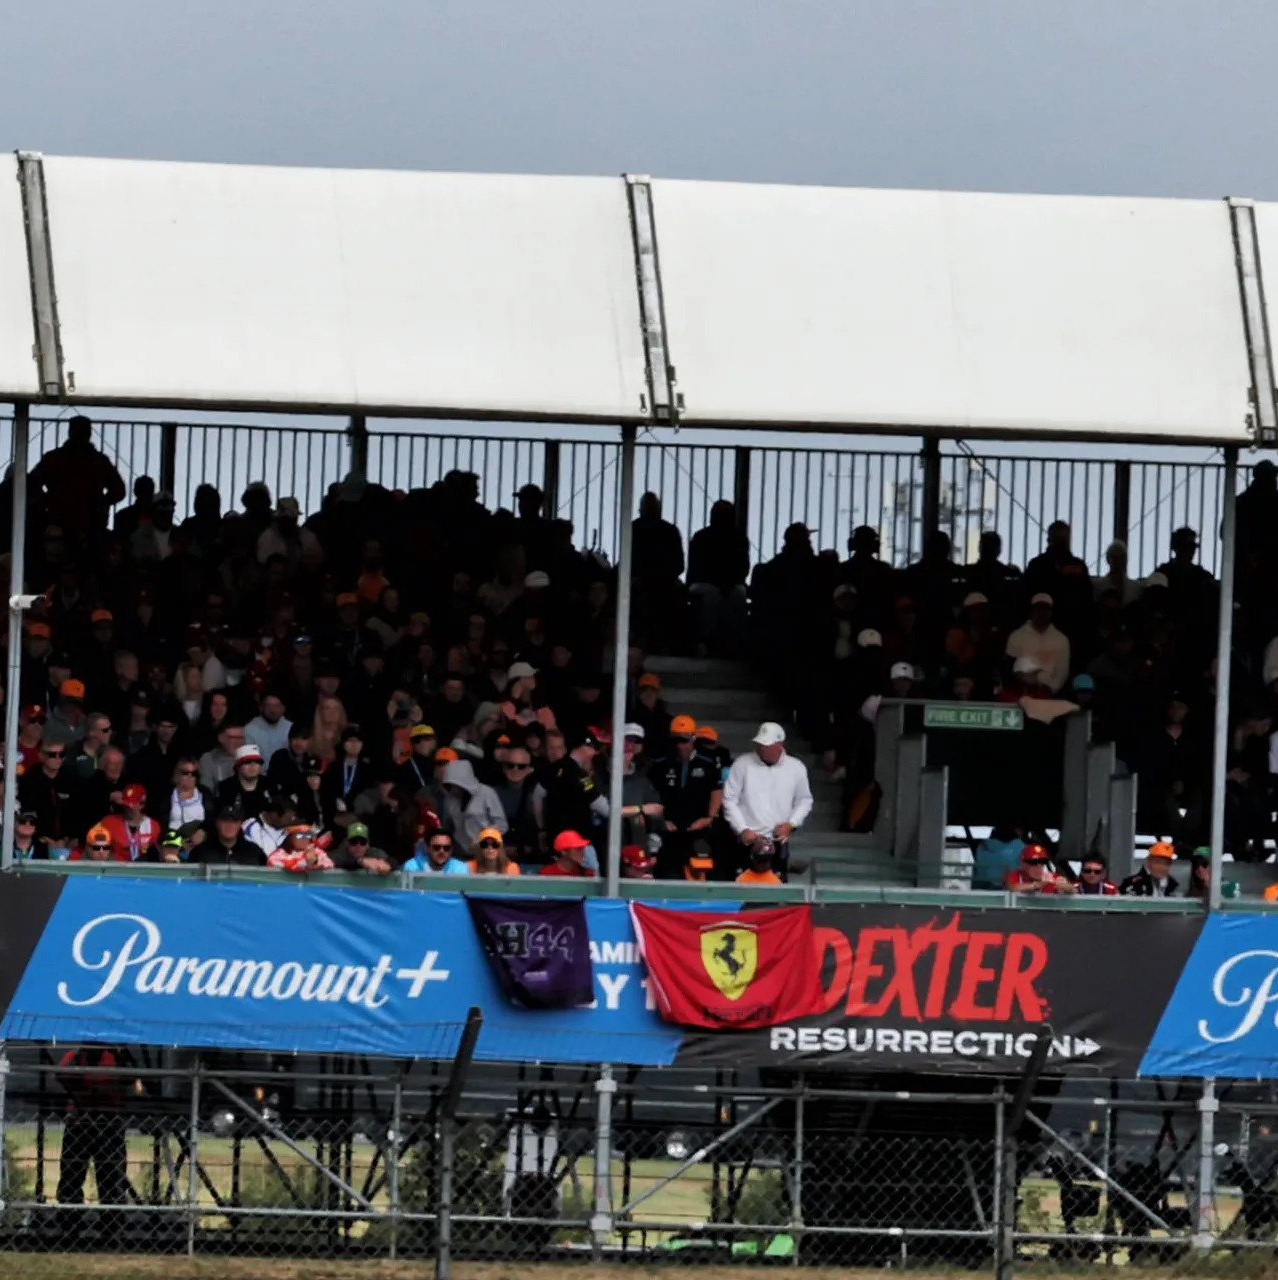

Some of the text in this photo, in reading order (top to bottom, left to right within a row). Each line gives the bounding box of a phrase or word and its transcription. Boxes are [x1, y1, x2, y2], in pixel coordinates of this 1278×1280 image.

[961, 711, 988, 723] EXIT
[58, 913, 450, 1008] Paramount+
[811, 911, 1049, 1022] DEXTER
